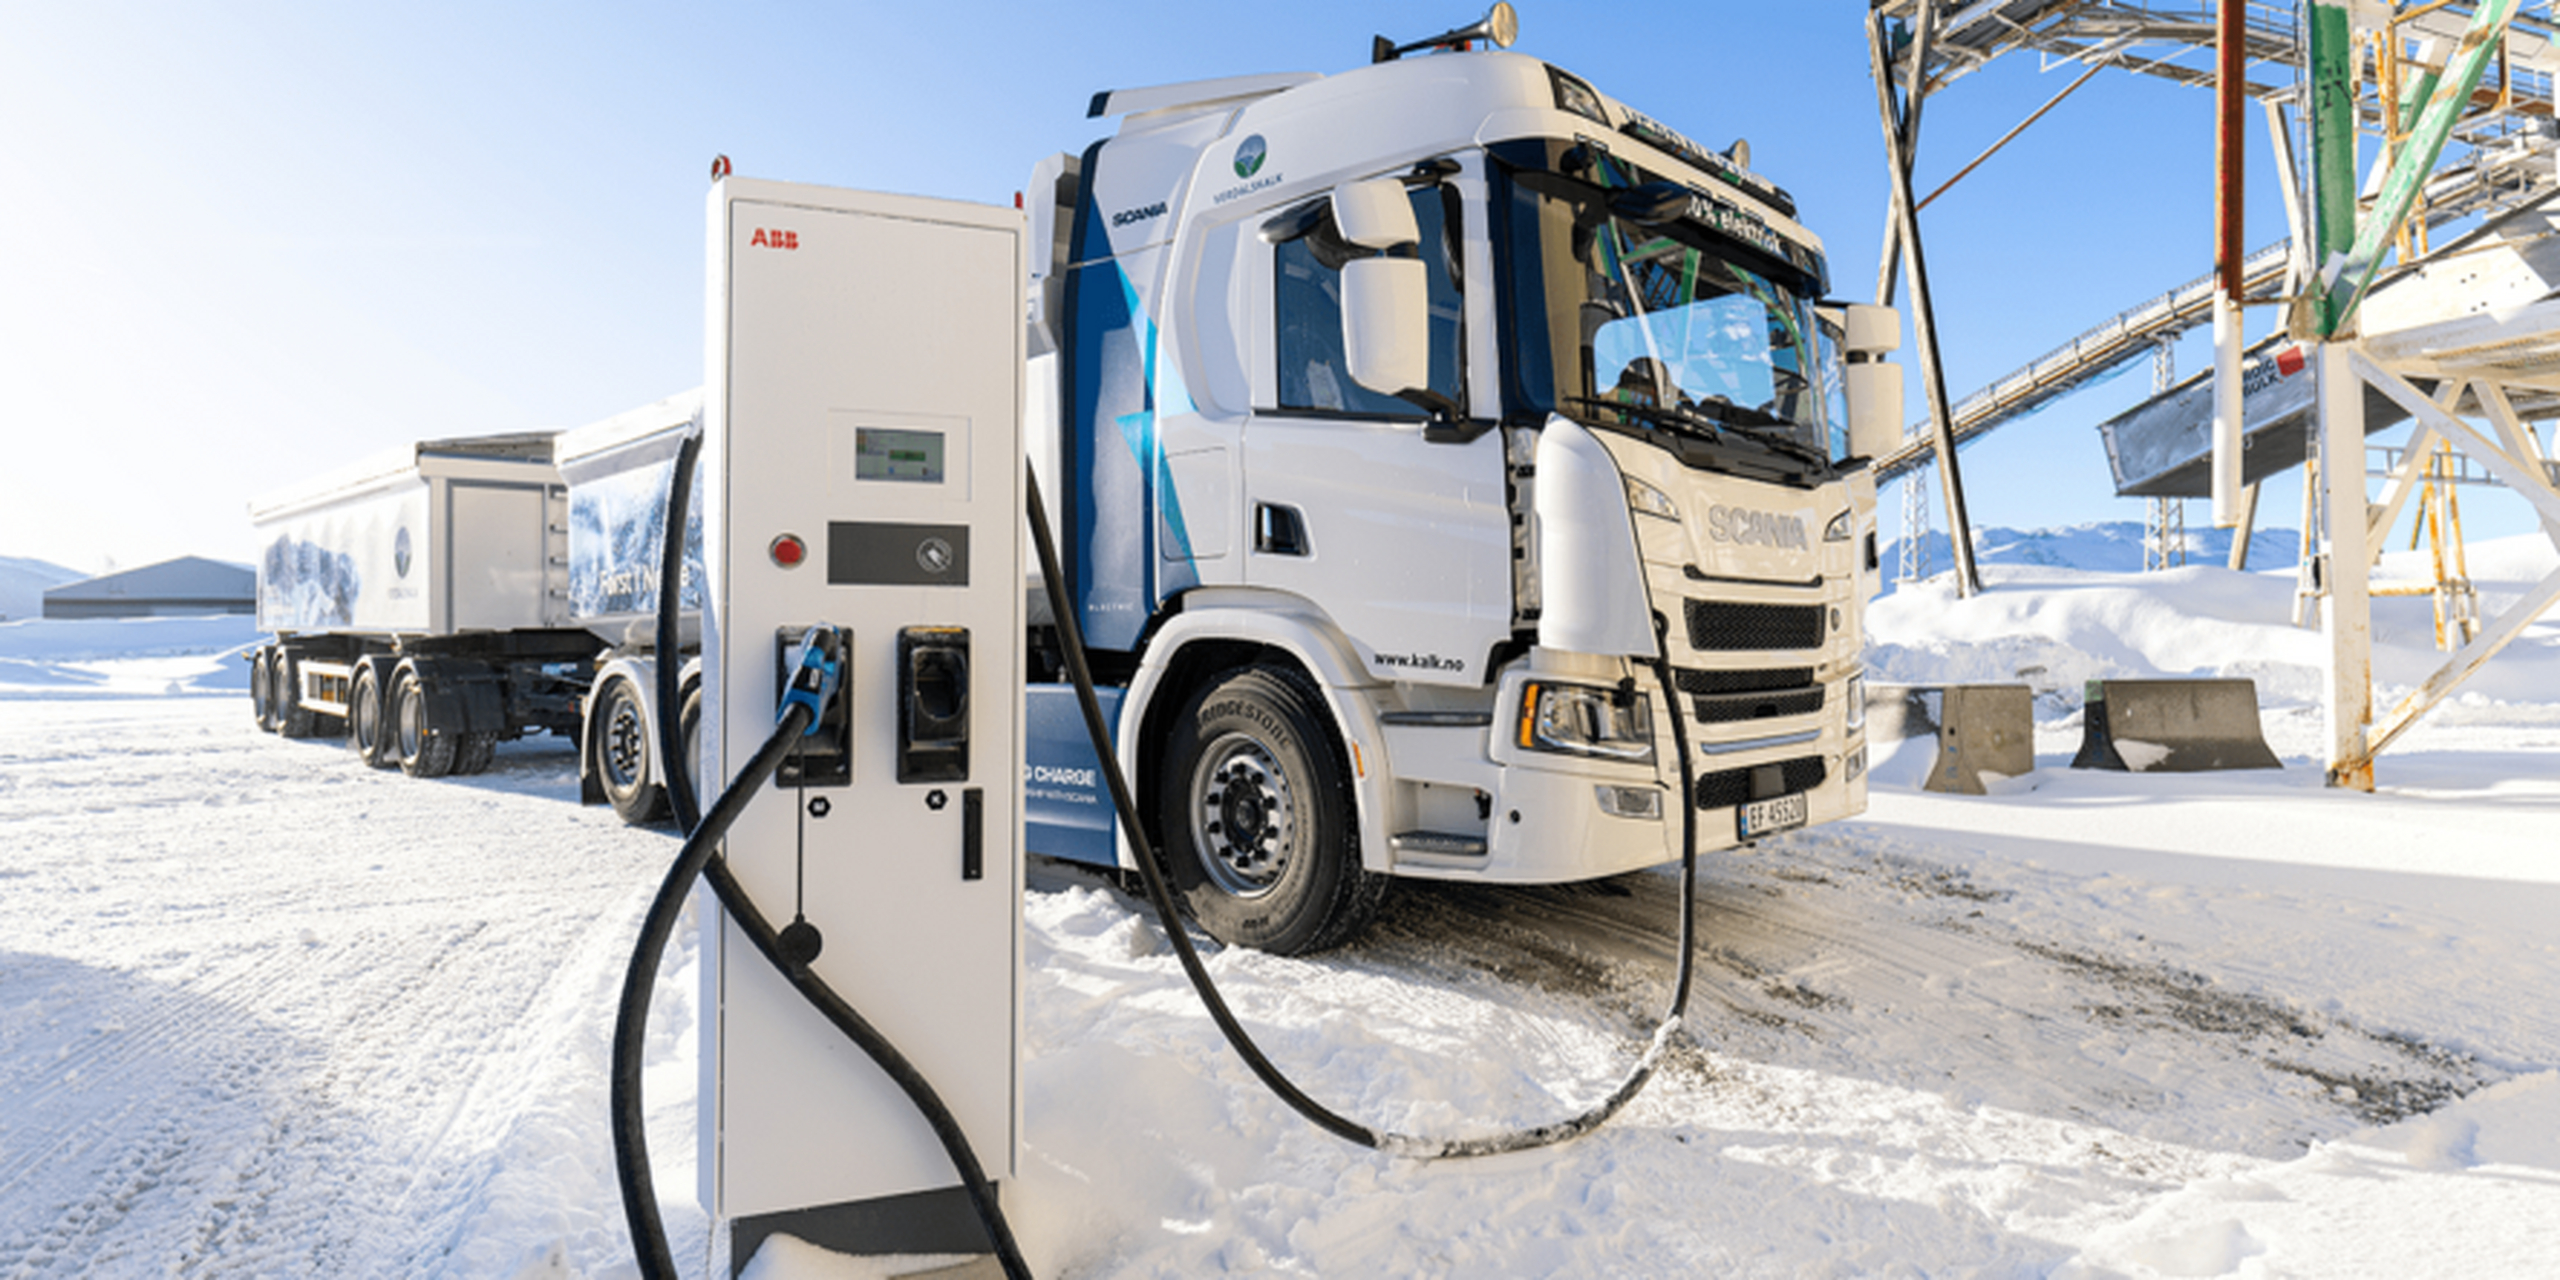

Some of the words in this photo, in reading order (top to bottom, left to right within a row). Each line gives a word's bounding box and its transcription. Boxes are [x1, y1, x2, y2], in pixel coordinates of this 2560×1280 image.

[1112, 201, 1169, 228] SCANIA
[750, 227, 799, 250] ABB
[1708, 503, 1808, 552] SCANIA
[1374, 652, 1466, 673] www.kalk.no
[1034, 765, 1096, 788] CHARGE
[1750, 804, 1763, 830] EF
